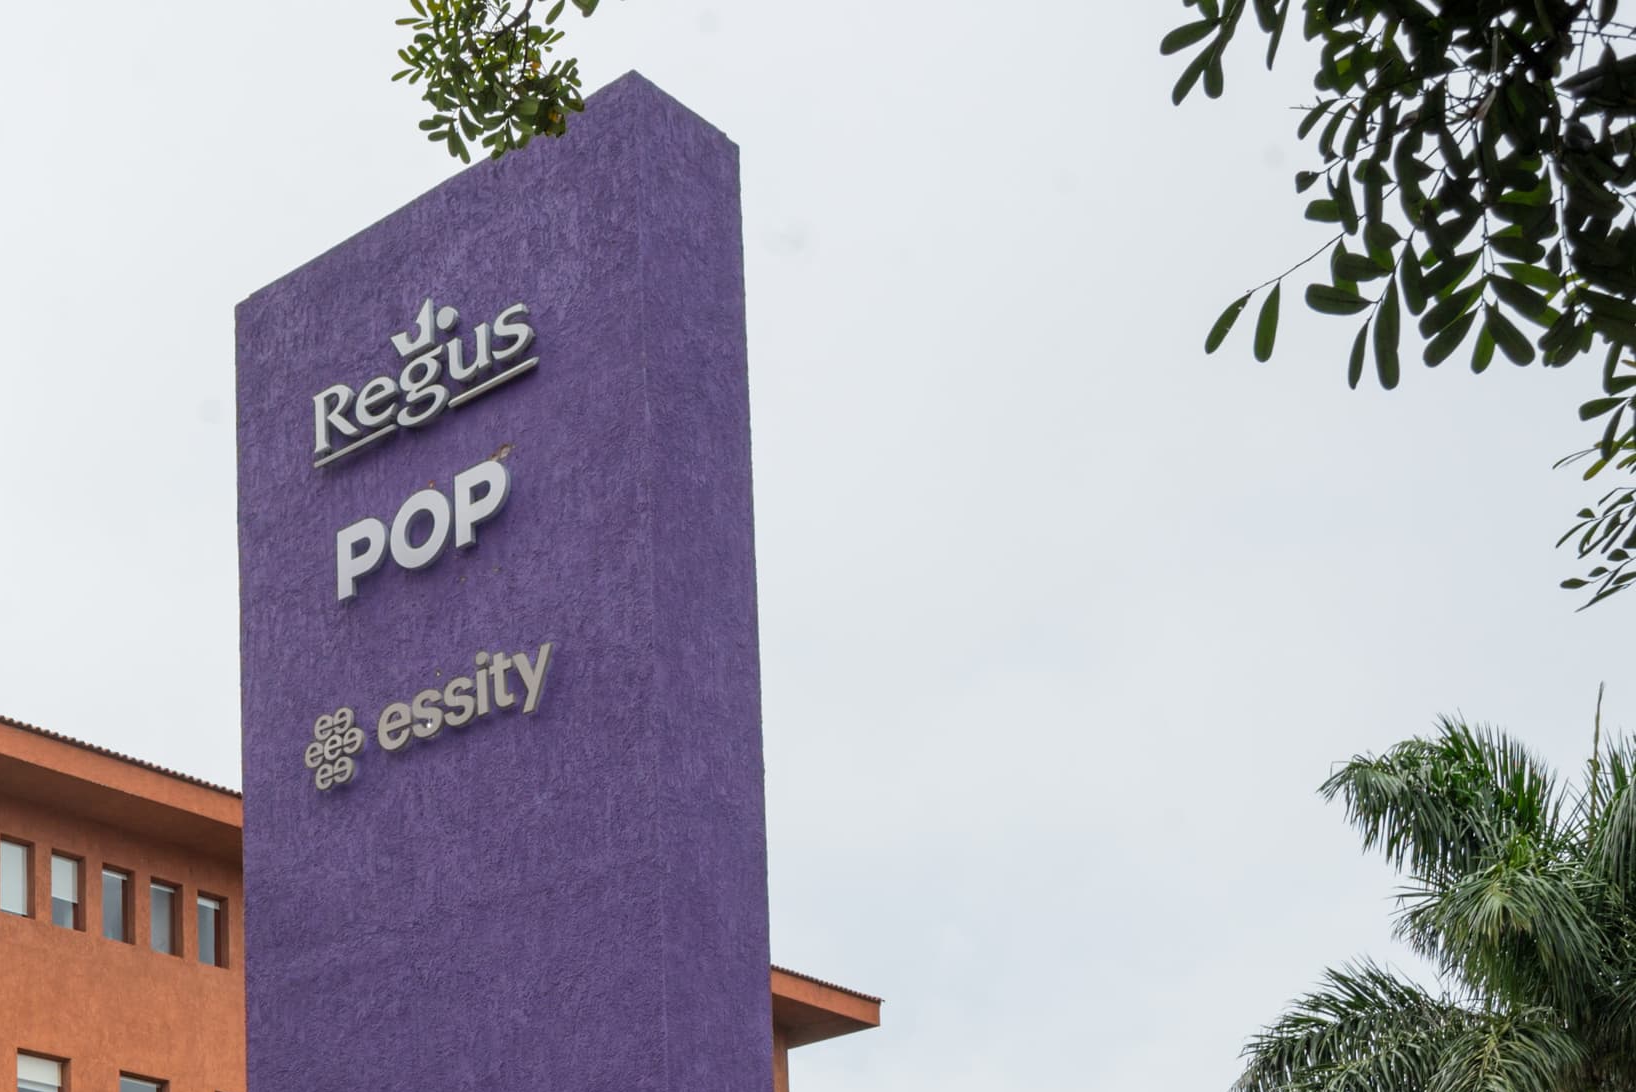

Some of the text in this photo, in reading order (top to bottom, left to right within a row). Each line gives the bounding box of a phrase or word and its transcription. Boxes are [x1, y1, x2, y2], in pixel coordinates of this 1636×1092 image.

[313, 300, 535, 453] Regus
[336, 460, 511, 601] POP
[377, 643, 554, 752] essity
